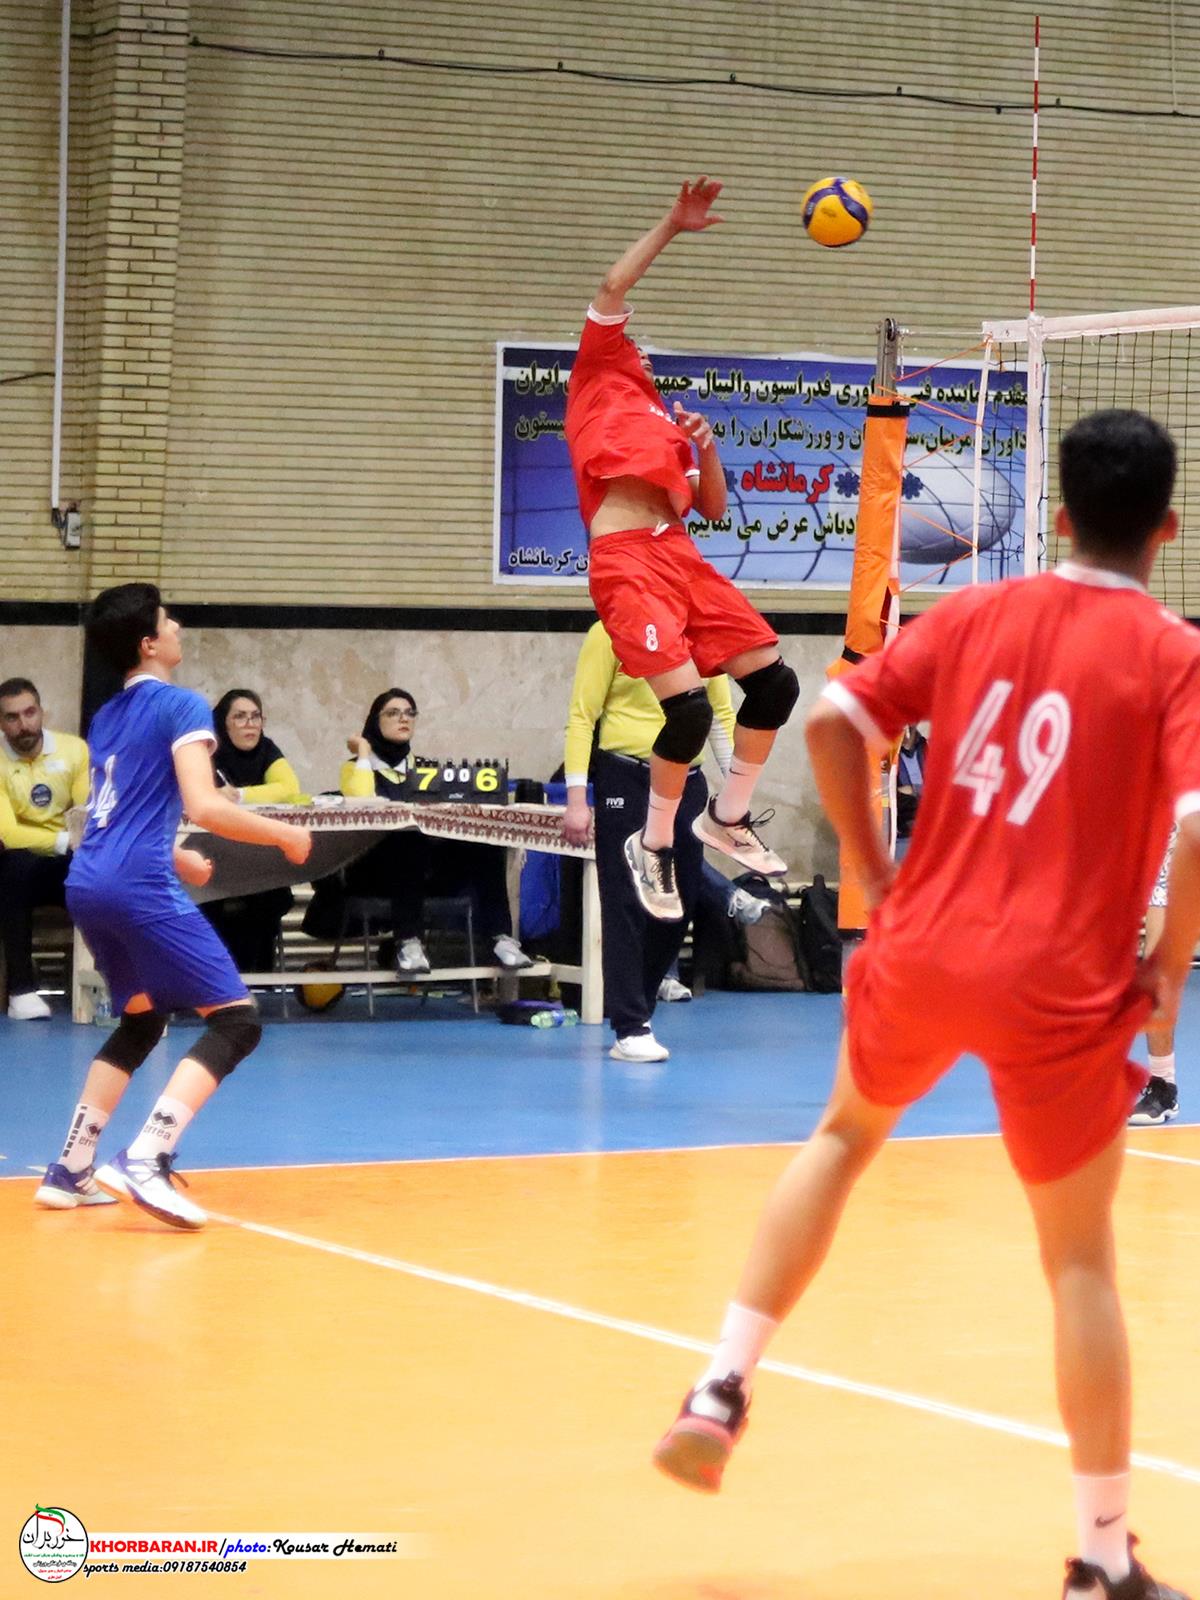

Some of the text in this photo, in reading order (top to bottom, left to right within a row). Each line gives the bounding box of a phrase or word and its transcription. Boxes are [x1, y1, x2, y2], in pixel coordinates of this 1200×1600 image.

[515, 360, 560, 396] ایران
[699, 368, 751, 404] والیبال
[755, 371, 832, 404] فدراسیون
[741, 459, 835, 504] کرمانشاه
[736, 516, 762, 541] می
[767, 511, 808, 541] عرض
[508, 547, 573, 573] کرمانشاه
[645, 623, 659, 652] 8
[952, 679, 1073, 827] 49
[416, 767, 438, 791] 7
[475, 767, 499, 792] 6
